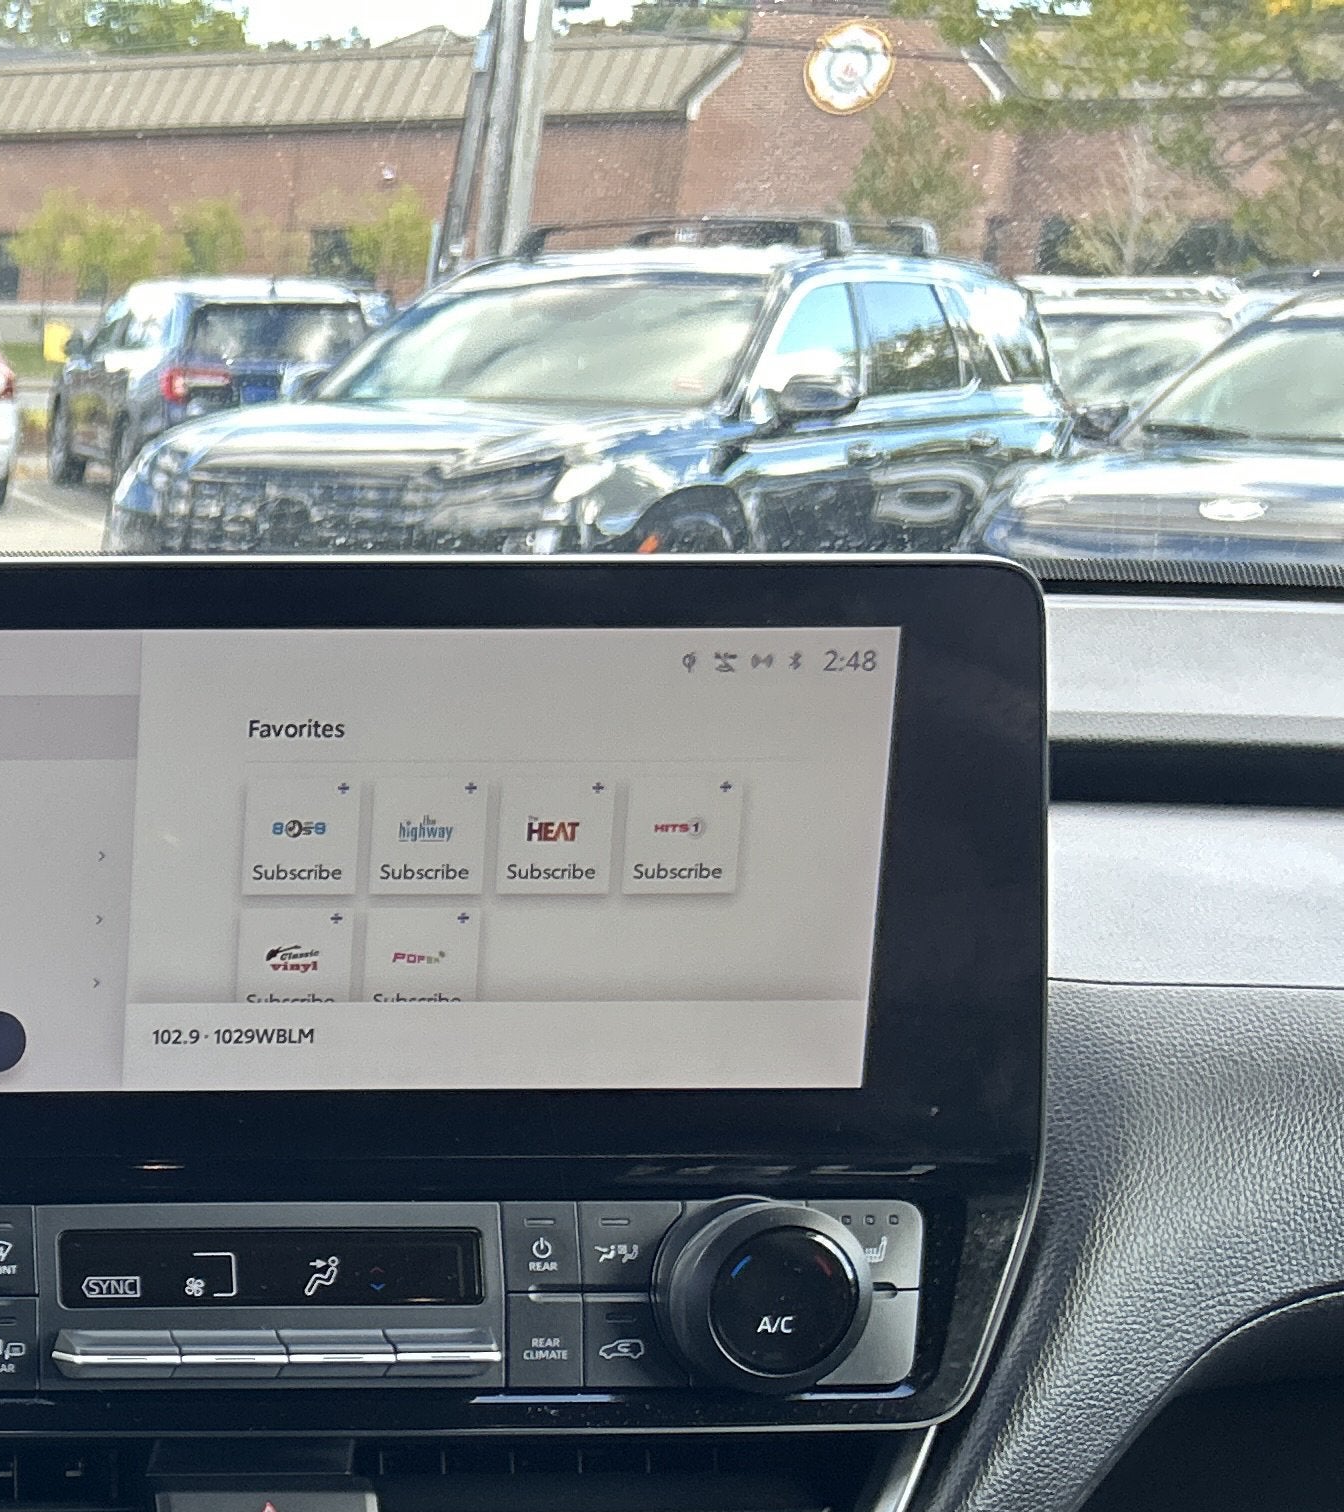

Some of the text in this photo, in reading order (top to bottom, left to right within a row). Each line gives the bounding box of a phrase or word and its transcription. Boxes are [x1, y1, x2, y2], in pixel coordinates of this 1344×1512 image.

[823, 649, 878, 672] 2:48
[247, 719, 346, 740] Favorites
[399, 820, 454, 842] highway
[526, 821, 580, 842] HEAT
[653, 823, 689, 834] HITS
[252, 863, 343, 882] Subscribe
[379, 863, 470, 882] Subscribe
[506, 862, 596, 881] Subscribe
[633, 862, 723, 881] Subscribe
[152, 1028, 315, 1046] 102.9 1029WBLM
[528, 1261, 558, 1272] REAR
[88, 1279, 136, 1296] SYNC
[756, 1315, 795, 1335] A/C
[531, 1337, 561, 1348] REAR
[523, 1349, 568, 1361] CLIMATE
